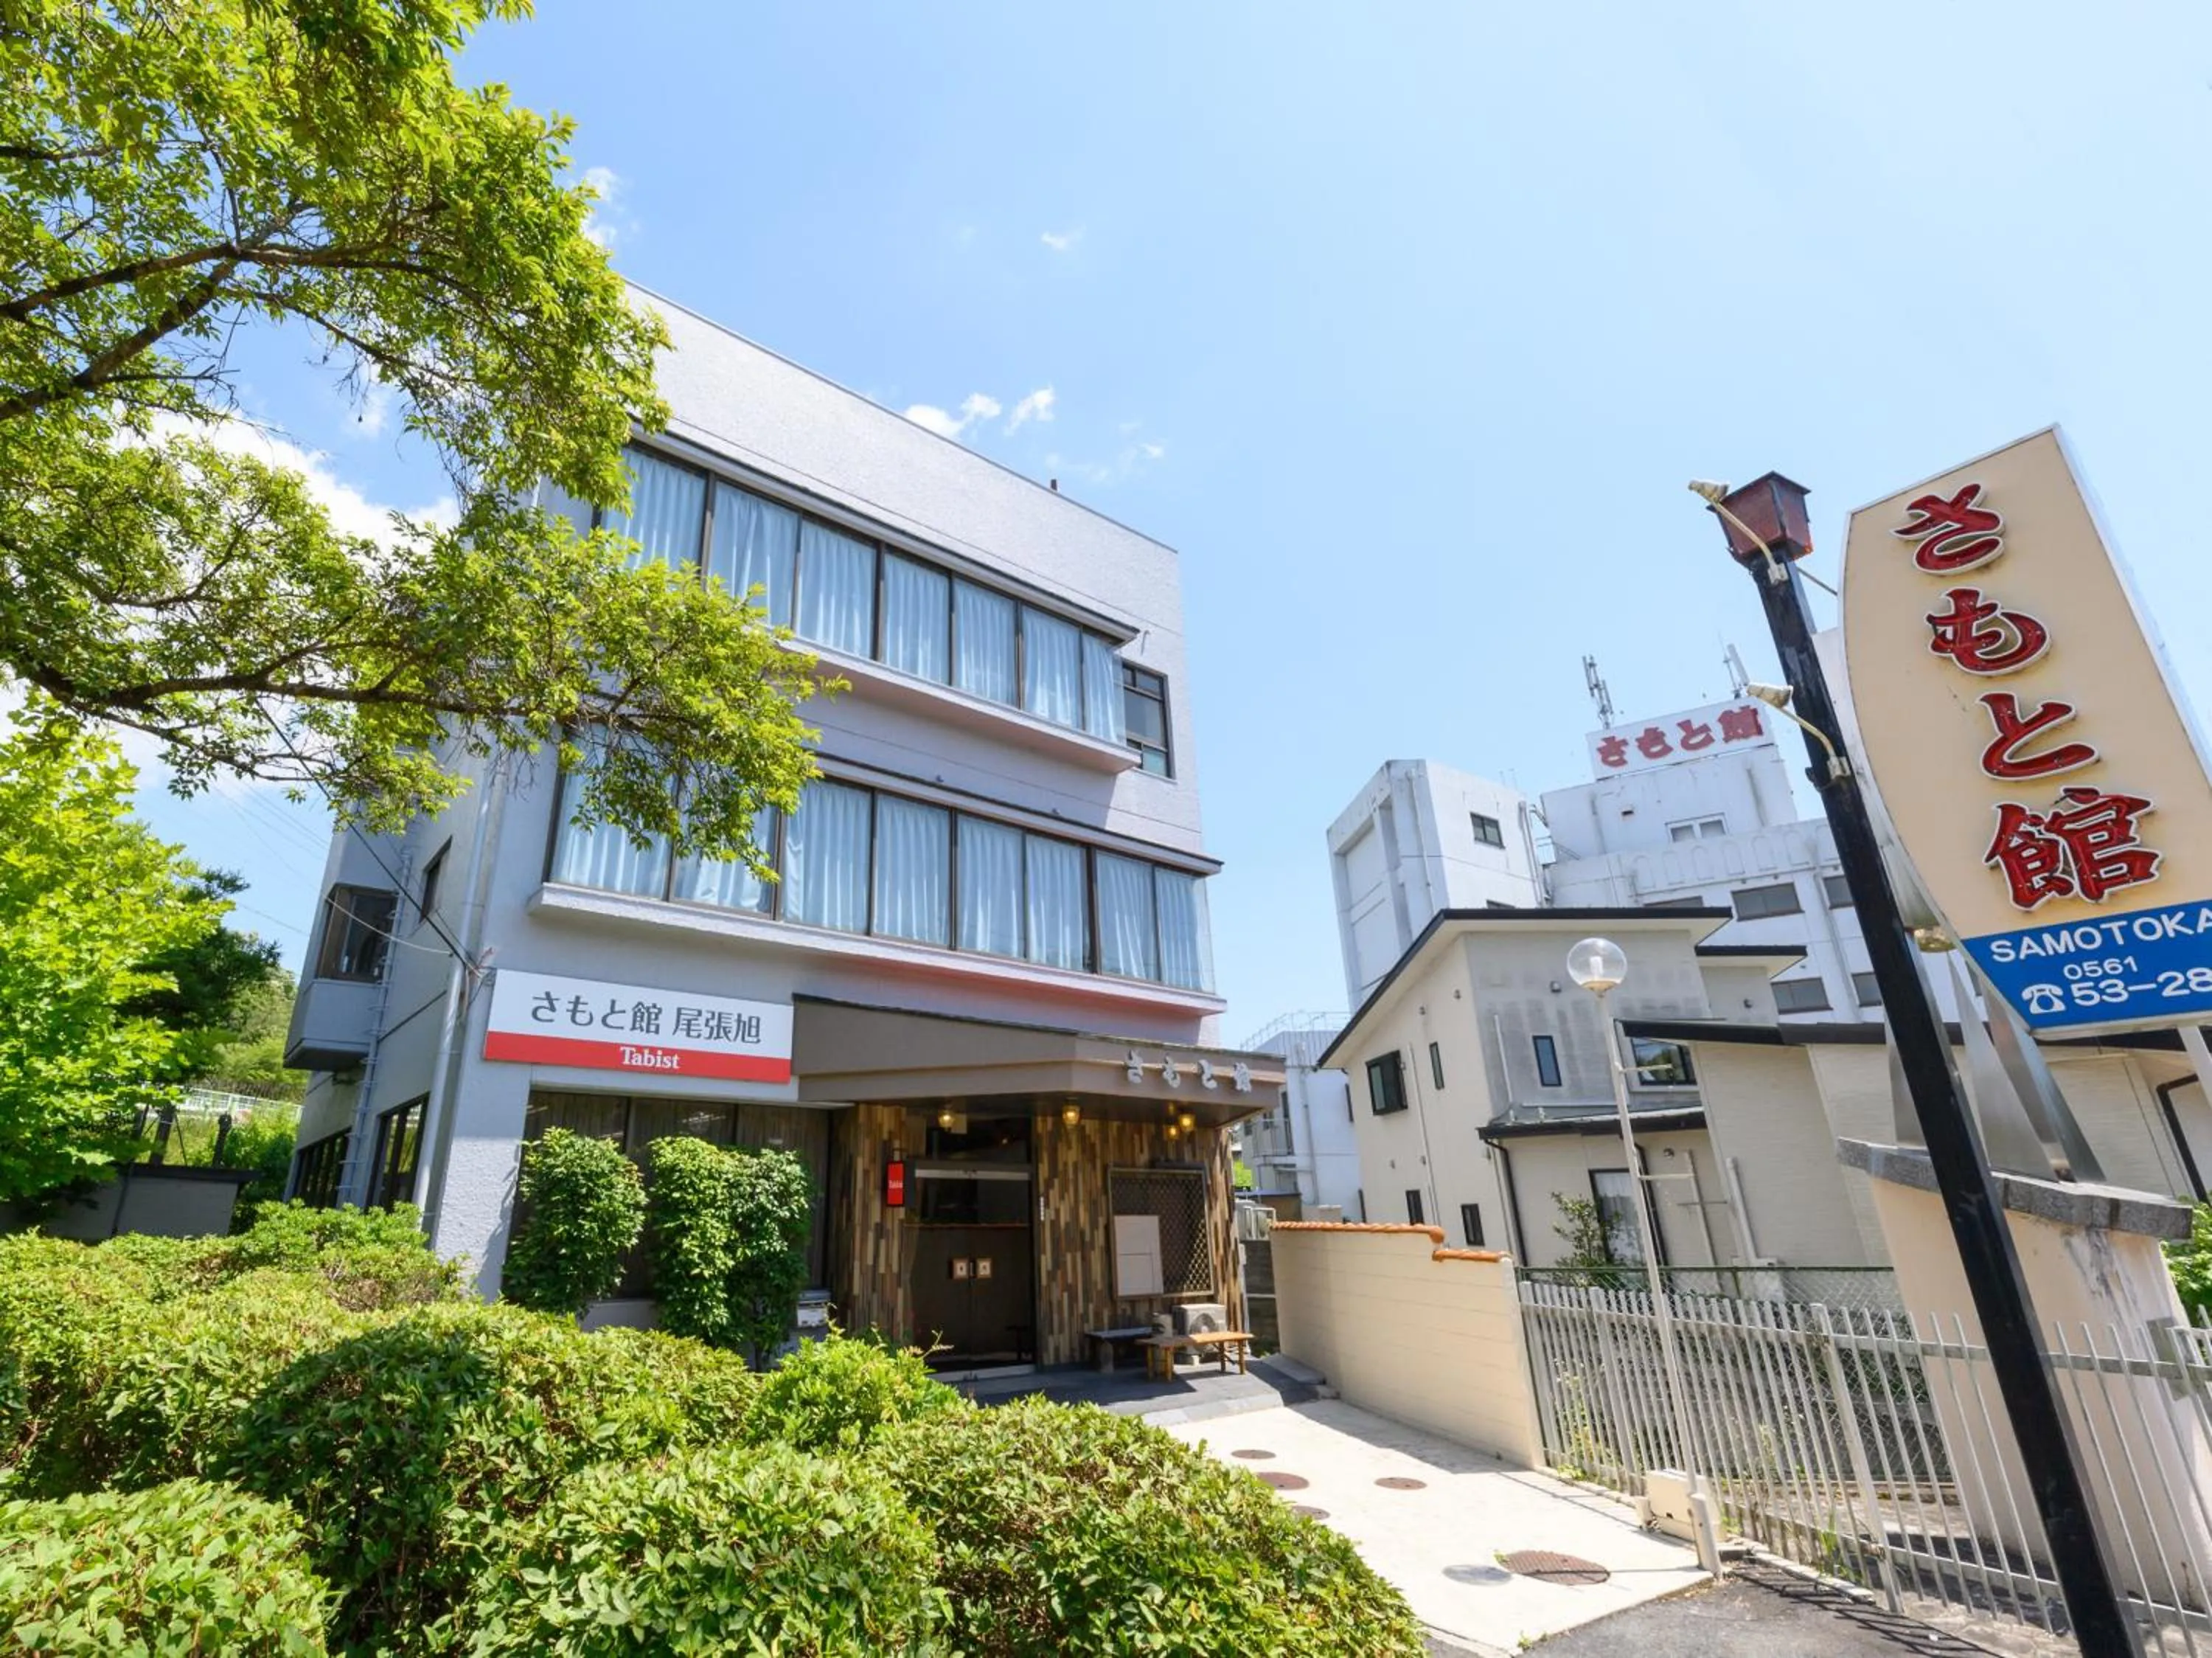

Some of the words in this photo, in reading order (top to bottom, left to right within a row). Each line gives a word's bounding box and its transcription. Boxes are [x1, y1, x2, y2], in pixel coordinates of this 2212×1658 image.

[1890, 482, 2163, 913] さもと館
[1596, 704, 1764, 768] さもと館
[1990, 907, 2212, 962] SAMOTOKA
[2063, 956, 2138, 980] 0561
[531, 991, 662, 1036] さもと館
[672, 1007, 761, 1044] 尾張旭
[620, 1046, 681, 1069] Tabist
